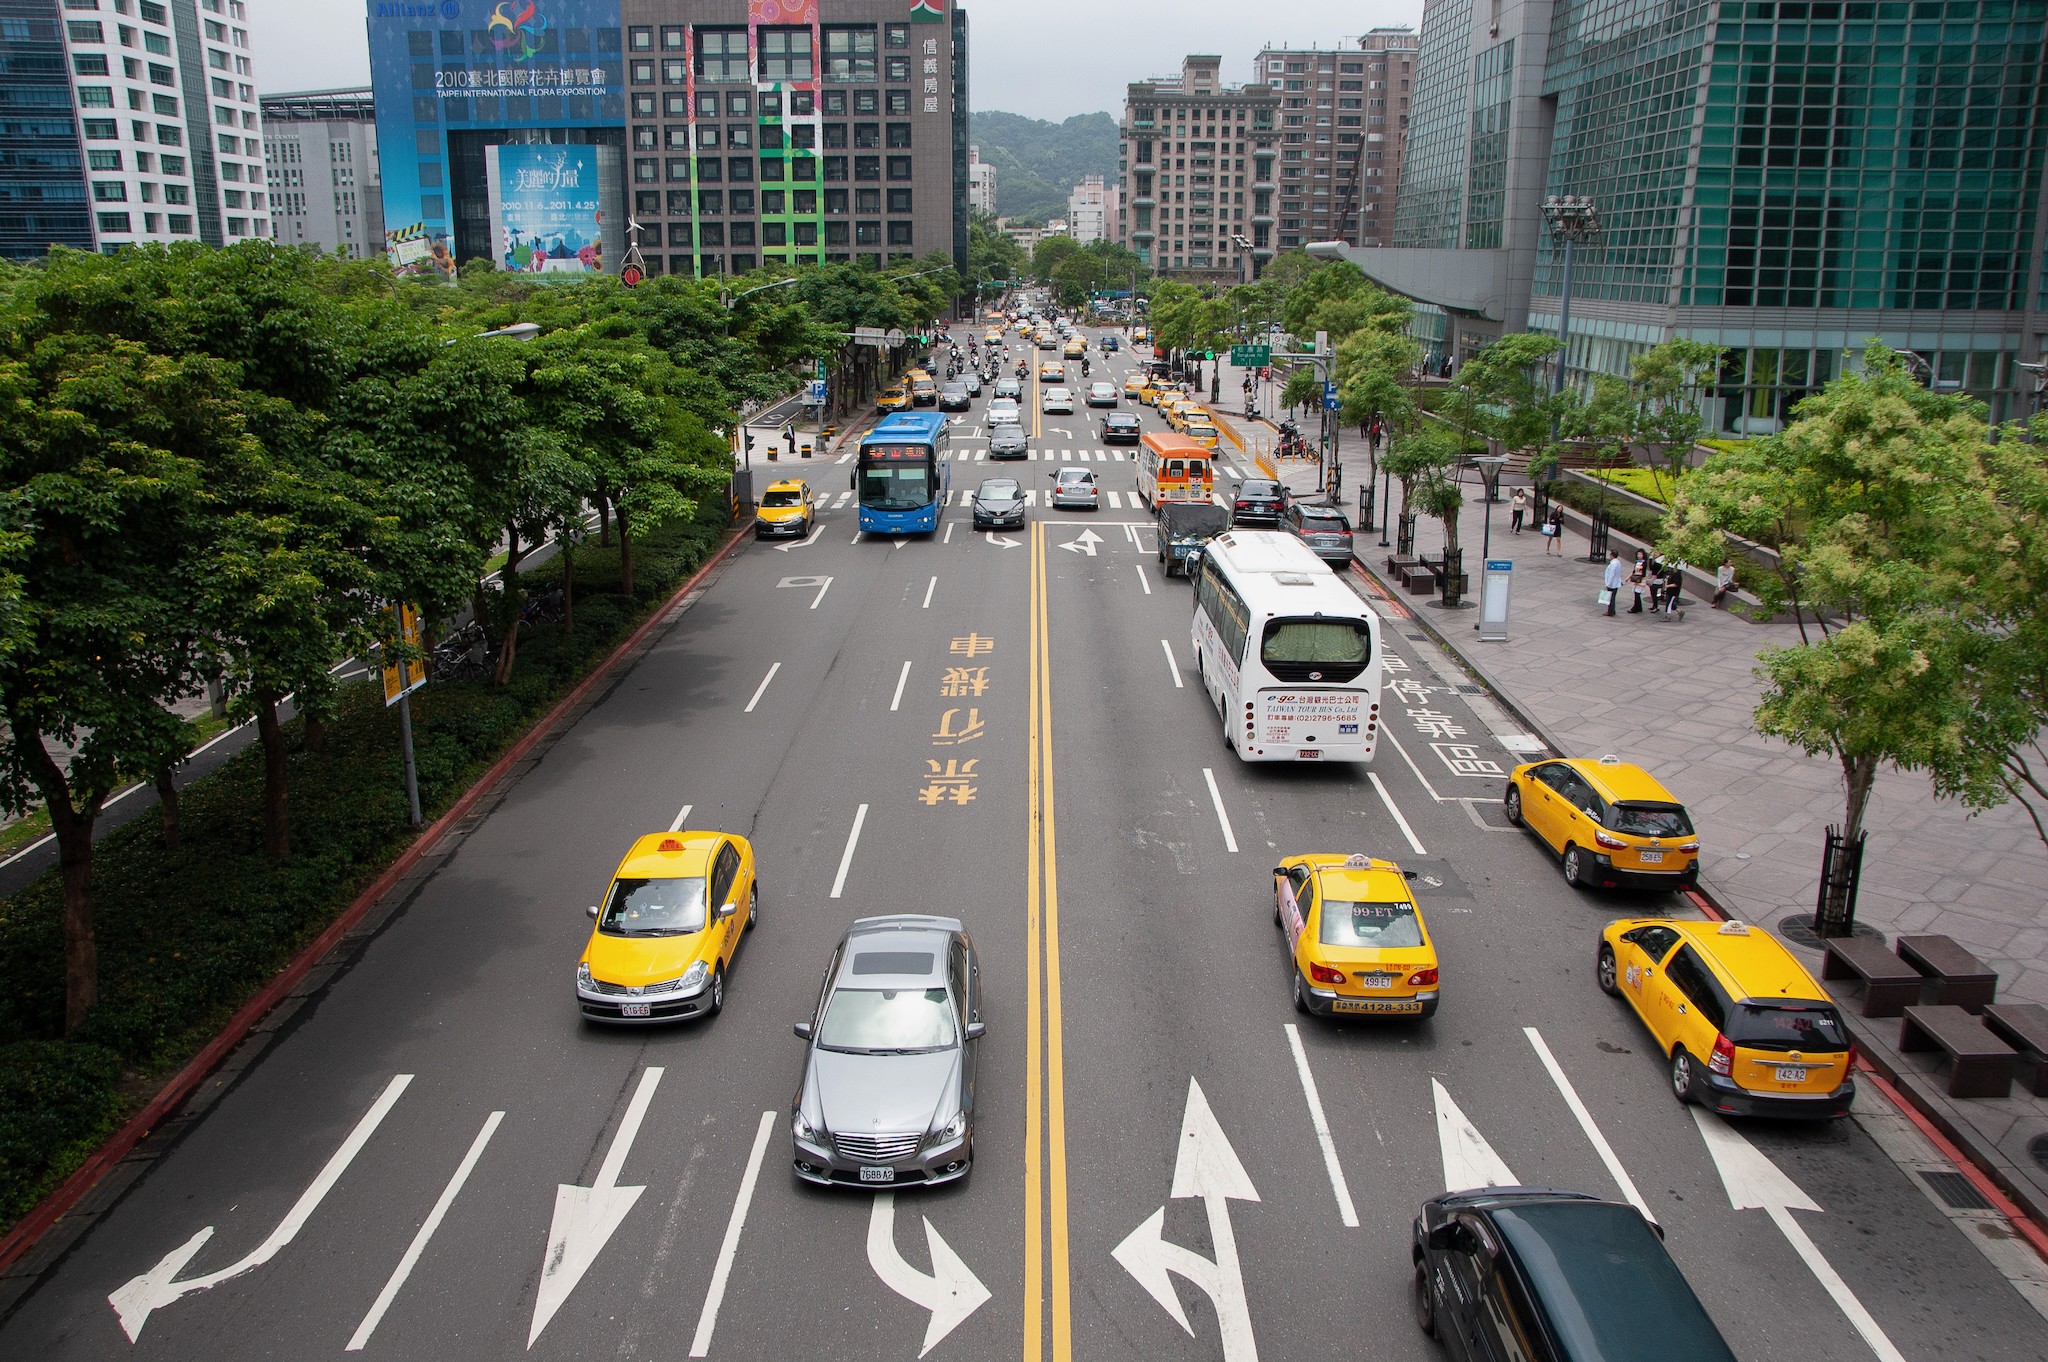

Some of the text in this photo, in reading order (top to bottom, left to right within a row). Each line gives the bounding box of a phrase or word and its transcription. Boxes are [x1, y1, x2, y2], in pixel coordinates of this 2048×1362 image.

[377, 2, 436, 17] Allianz
[434, 68, 606, 88] 2010臺北國際花卉博覽會
[922, 38, 938, 113] 信義房屋
[436, 87, 606, 98] TAIPEI INTERNATIONAL FLORA EXPOSITION
[513, 164, 579, 192] 美麗的力量
[815, 383, 824, 394] P
[1266, 705, 1295, 713] TAIWAN
[1298, 705, 1318, 713] TOUR
[918, 632, 995, 806] 禁行機車
[1349, 906, 1394, 917] 99-ET
[1361, 1003, 1420, 1011] 4128-333
[1778, 1069, 1805, 1080] 142-A2
